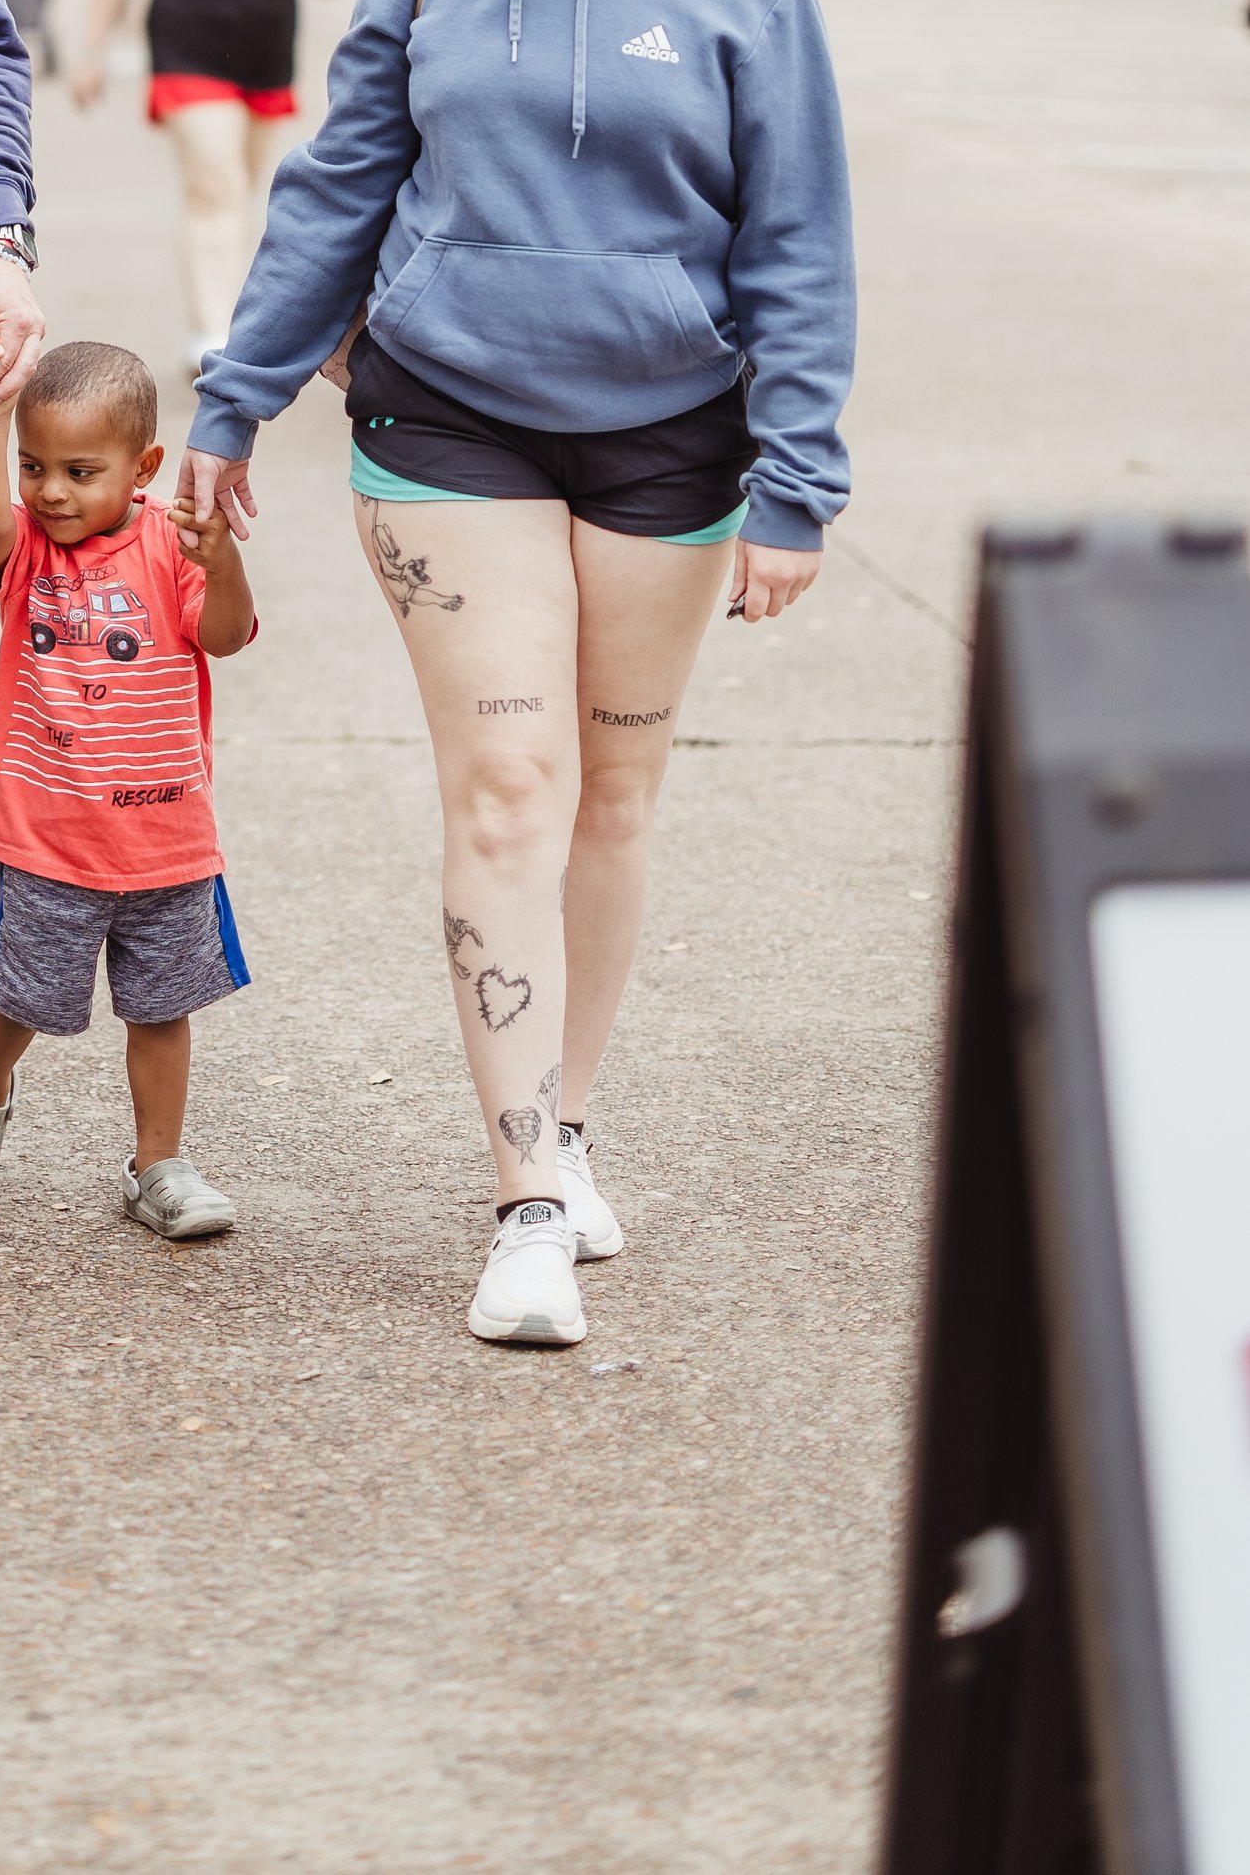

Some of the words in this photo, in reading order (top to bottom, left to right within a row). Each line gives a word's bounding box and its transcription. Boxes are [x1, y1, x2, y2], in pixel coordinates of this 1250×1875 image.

[621, 43, 679, 64] adidas
[81, 683, 106, 702] TO
[477, 697, 544, 715] DIVINE
[591, 706, 672, 727] FEMININE
[45, 726, 73, 748] THE
[111, 785, 183, 807] RESCUE!
[521, 1208, 550, 1223] DUDE
